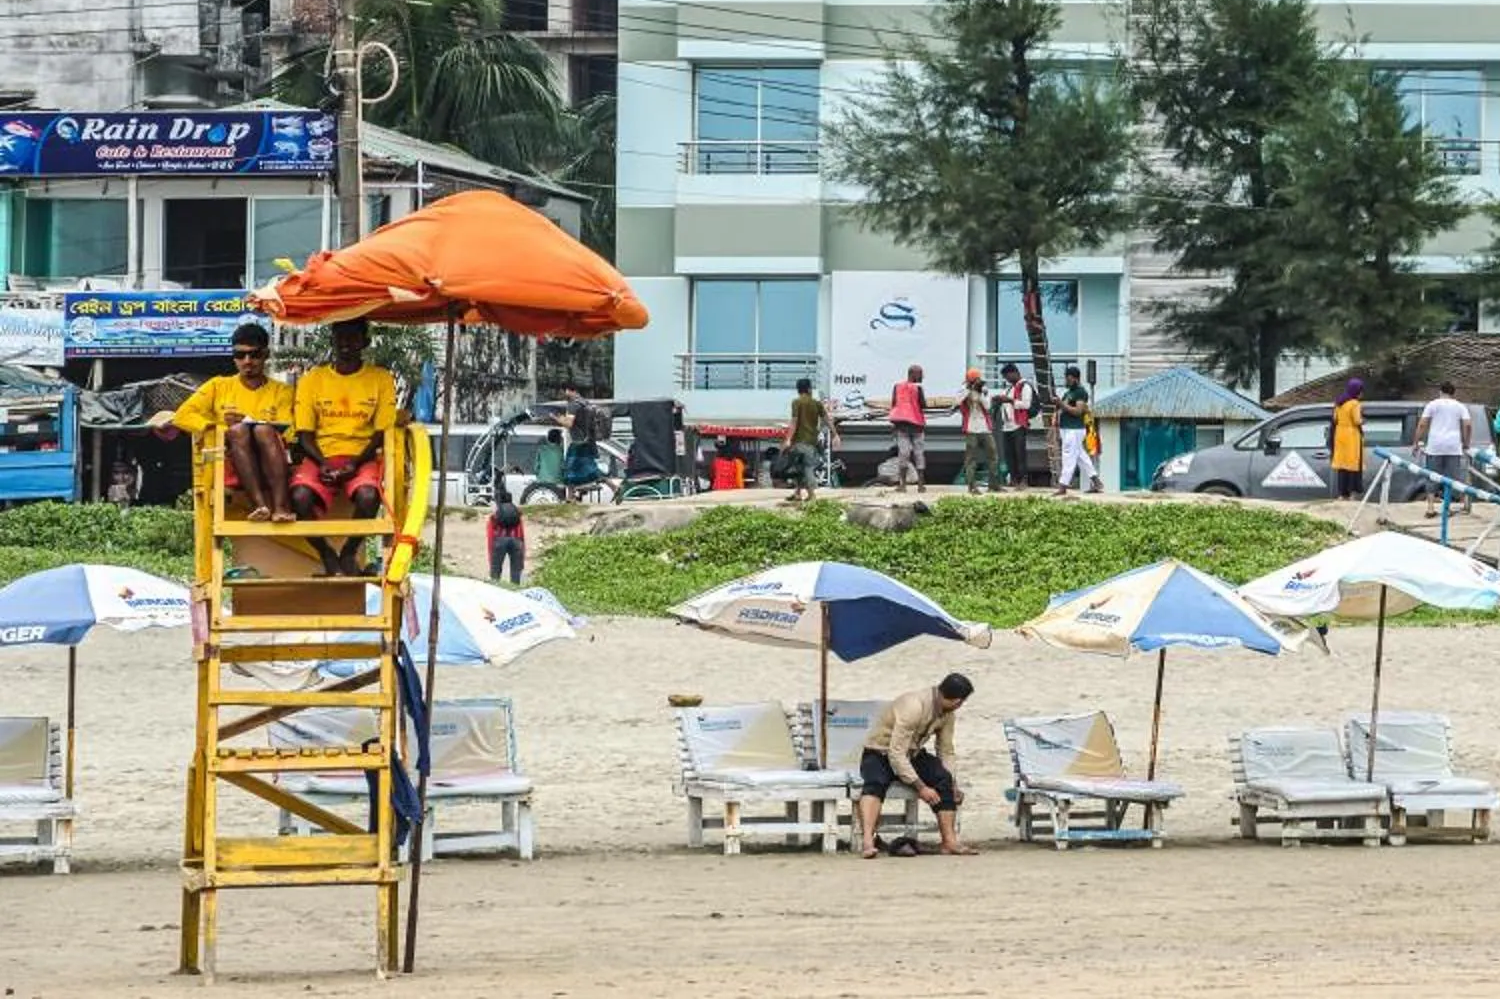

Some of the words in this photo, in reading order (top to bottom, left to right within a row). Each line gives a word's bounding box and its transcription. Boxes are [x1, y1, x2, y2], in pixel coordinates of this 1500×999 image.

[81, 118, 158, 141] Rain
[168, 118, 250, 146] Drop
[95, 145, 131, 159] Cafe
[149, 144, 236, 159] Restaurant
[153, 298, 198, 314] বাংলা
[834, 374, 866, 384] Hotel
[495, 611, 535, 634] BERGER
[0, 625, 47, 643] GER
